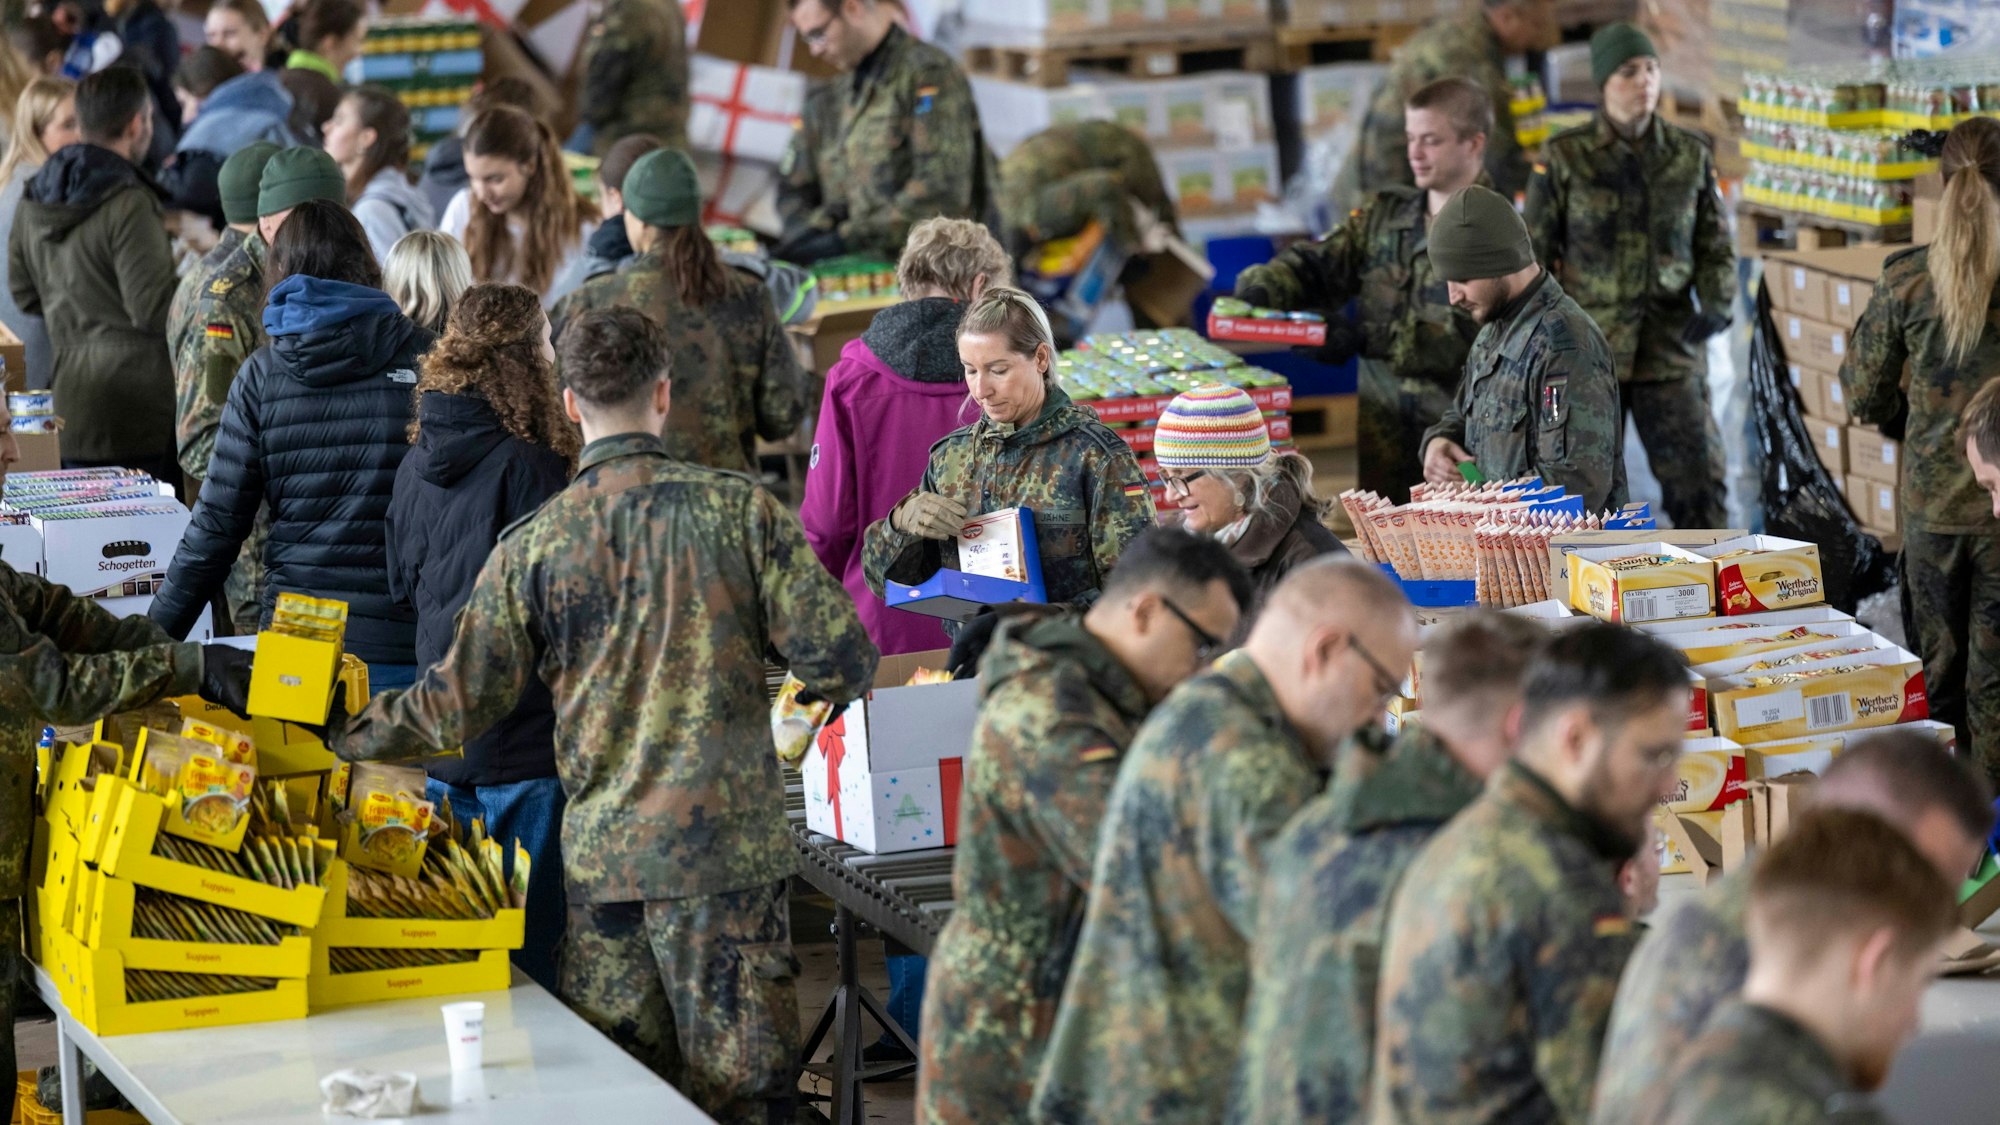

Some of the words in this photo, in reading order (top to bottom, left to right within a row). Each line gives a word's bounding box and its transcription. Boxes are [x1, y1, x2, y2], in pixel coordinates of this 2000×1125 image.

[1043, 511, 1071, 522] JÄHNE
[98, 560, 156, 572] Schogetten
[1776, 577, 1819, 591] Werther's
[1678, 588, 1695, 597] 3000
[1788, 583, 1818, 598] Original
[1856, 693, 1899, 707] Werther's
[1868, 701, 1898, 714] Original
[200, 879, 236, 894] Suppen
[401, 928, 437, 938] Suppen
[185, 952, 221, 963] Suppen
[387, 977, 423, 989] Suppen
[183, 1007, 220, 1018] Suppen
